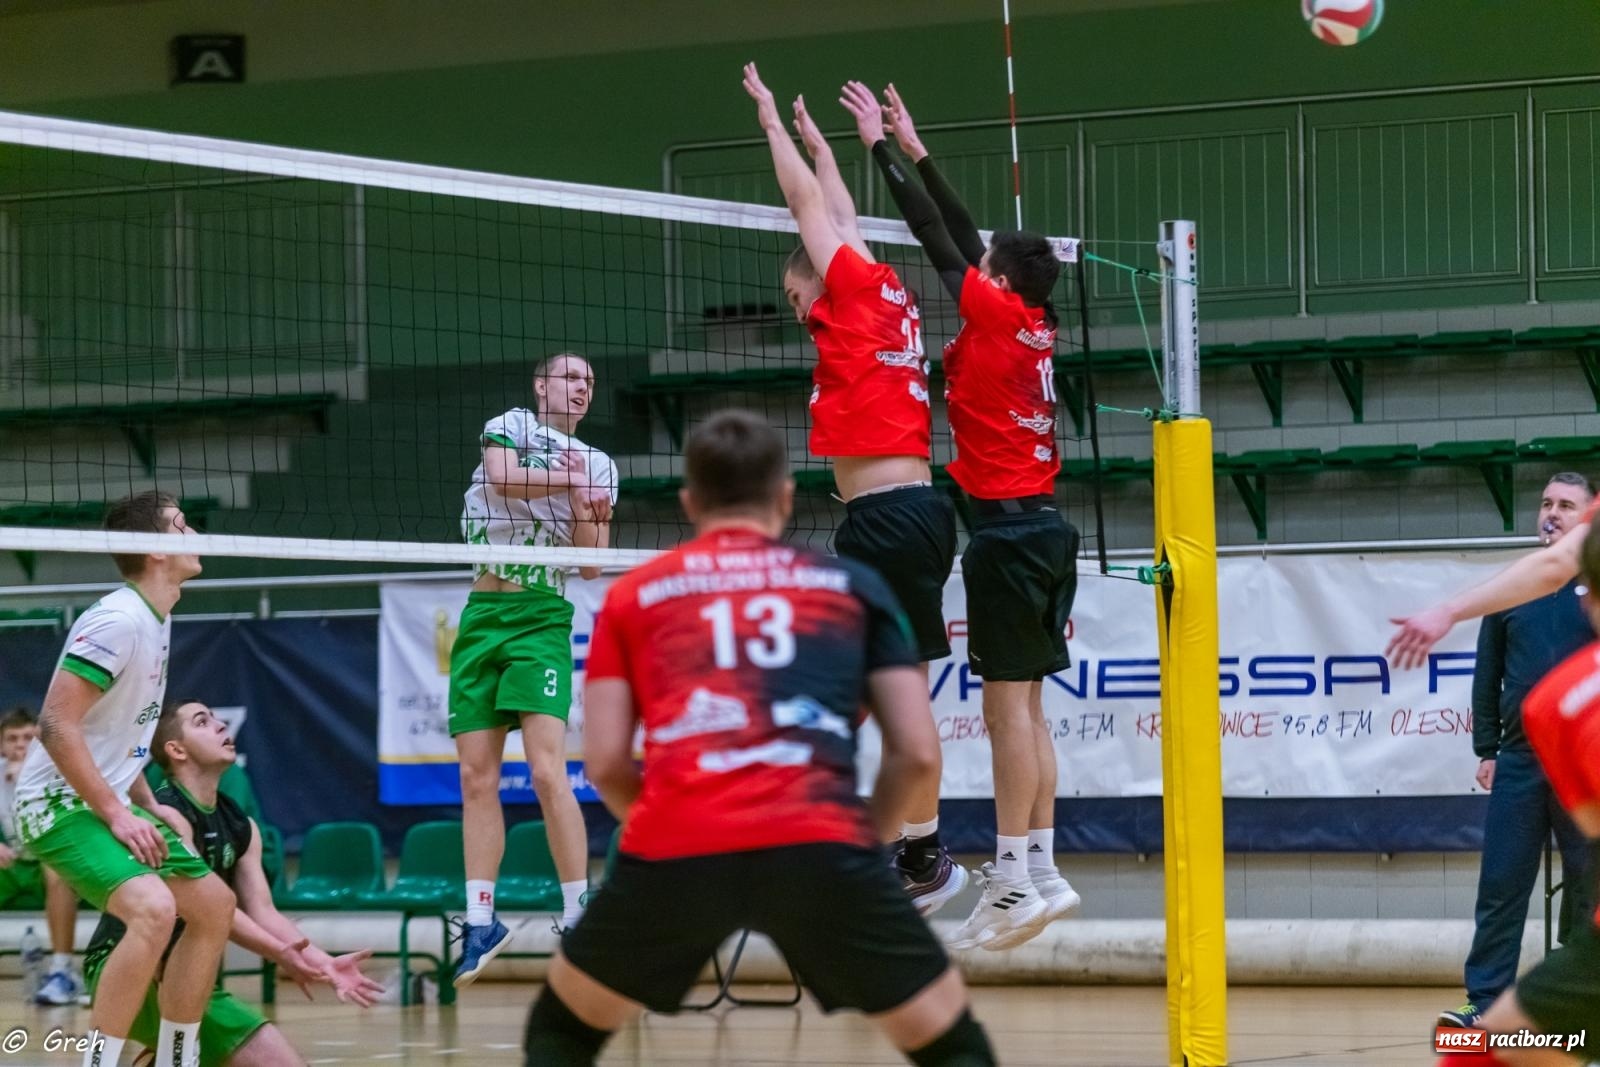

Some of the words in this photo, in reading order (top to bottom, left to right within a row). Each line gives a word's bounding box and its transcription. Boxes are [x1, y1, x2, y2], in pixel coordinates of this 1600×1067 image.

[188, 51, 234, 77] A
[700, 591, 797, 671] 13
[543, 668, 558, 697] 3
[1076, 711, 1115, 742] FM
[1282, 713, 1330, 738] 95,8
[1335, 709, 1373, 739] FM
[1390, 707, 1475, 737] OLESN
